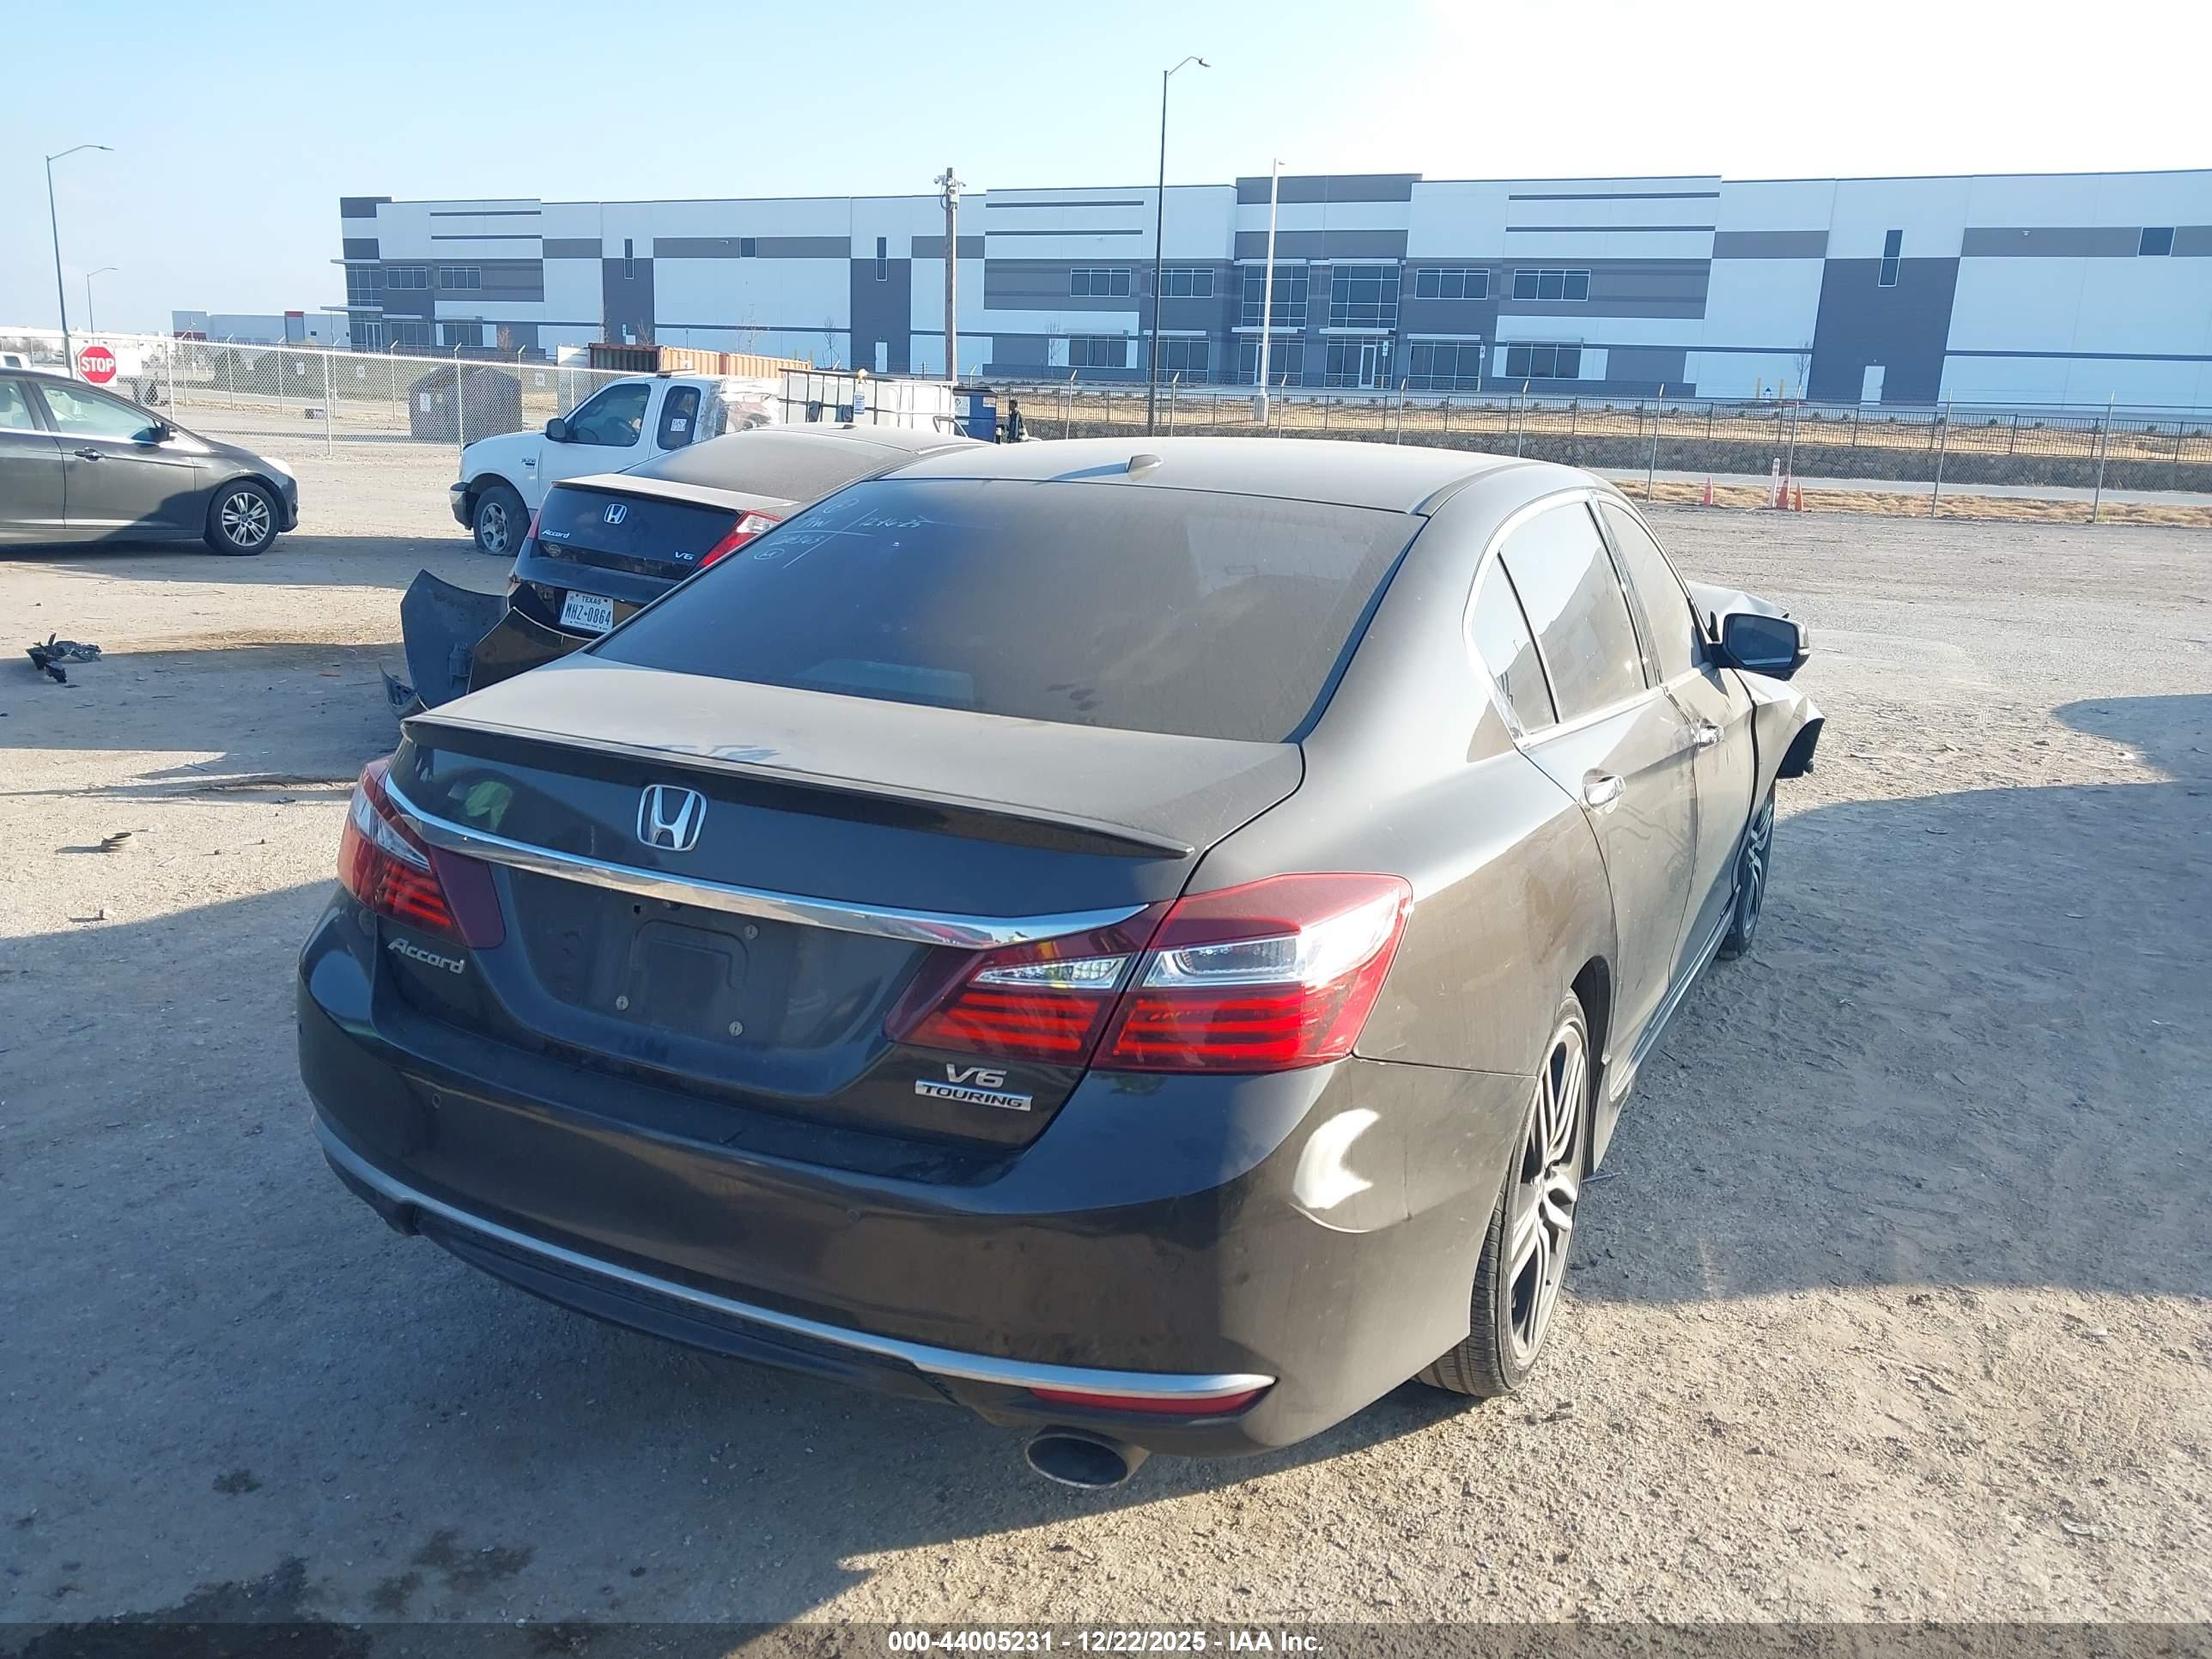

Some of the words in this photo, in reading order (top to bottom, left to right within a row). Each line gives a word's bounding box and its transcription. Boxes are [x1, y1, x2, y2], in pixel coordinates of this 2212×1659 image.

[82, 356, 114, 373] STOP
[542, 529, 570, 539] Accord
[675, 551, 695, 560] V6
[582, 596, 602, 605] TEXAS
[387, 938, 465, 974] Accord
[946, 1063, 1007, 1088] V6
[922, 1084, 1024, 1109] TOURING
